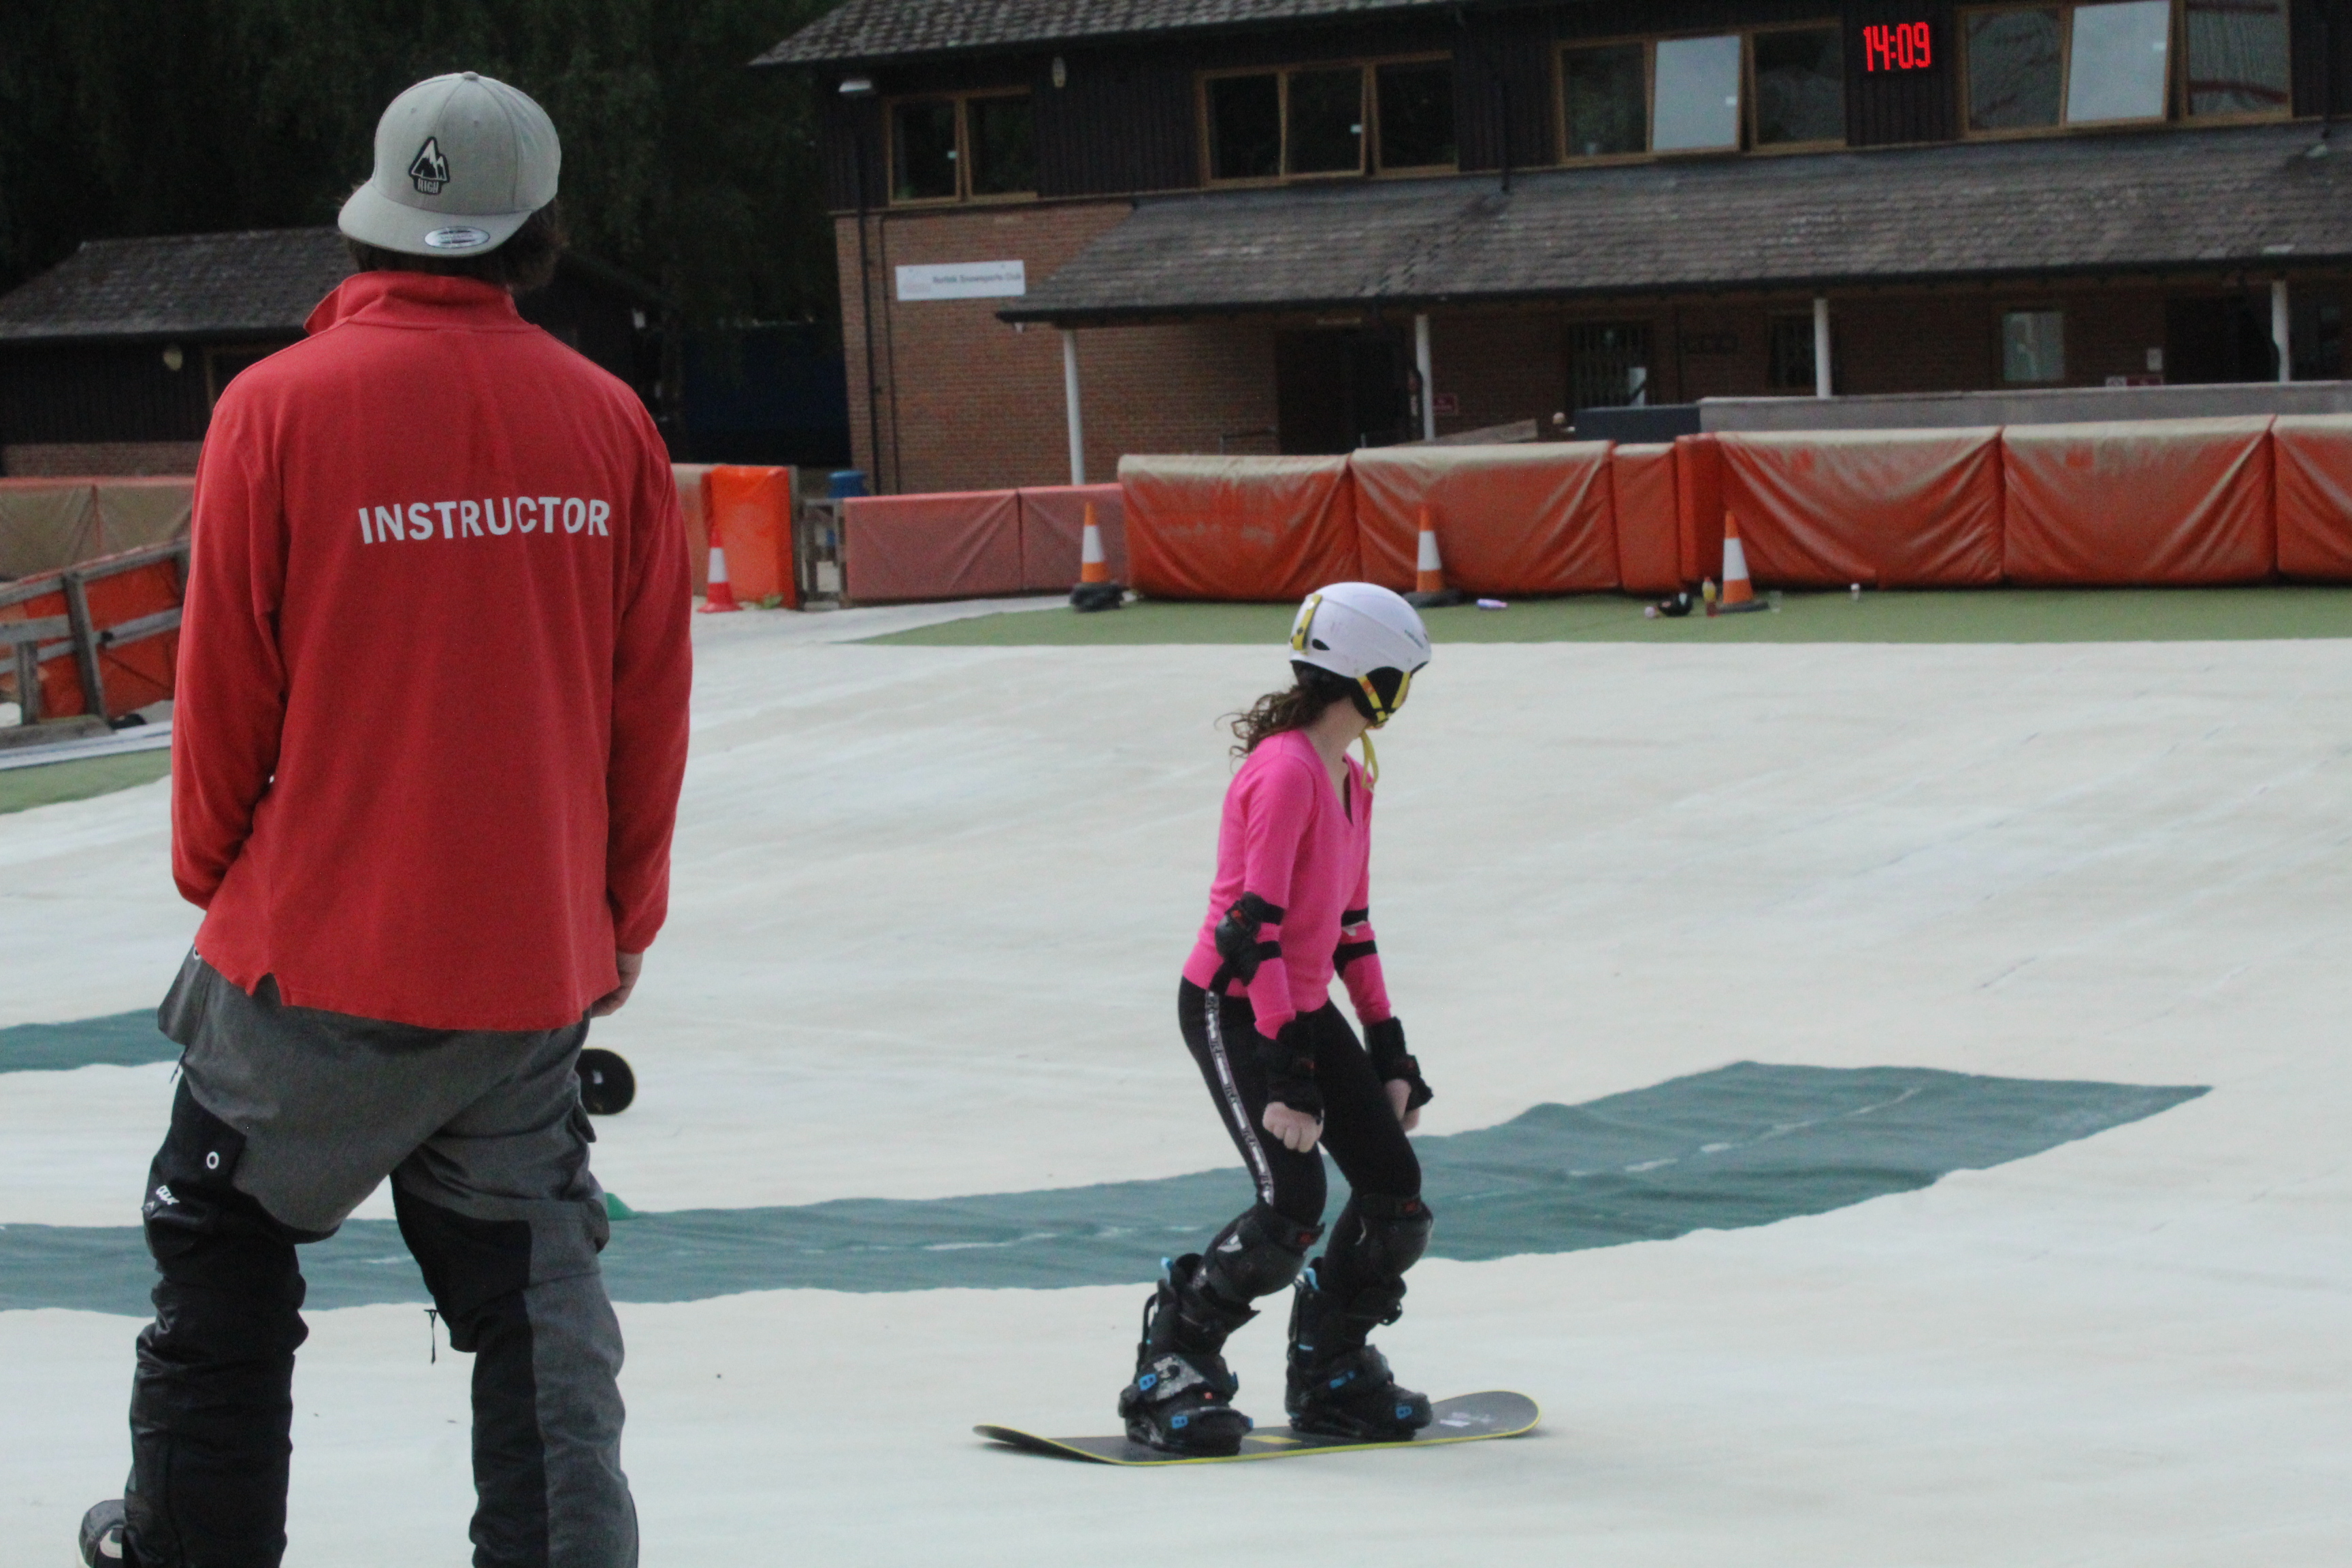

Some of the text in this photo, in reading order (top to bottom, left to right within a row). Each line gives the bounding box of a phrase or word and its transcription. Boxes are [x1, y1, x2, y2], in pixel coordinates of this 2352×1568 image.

[1863, 21, 1931, 72] 14:09
[417, 178, 440, 194] HIGH
[357, 496, 610, 544] INSTRUCTOR
